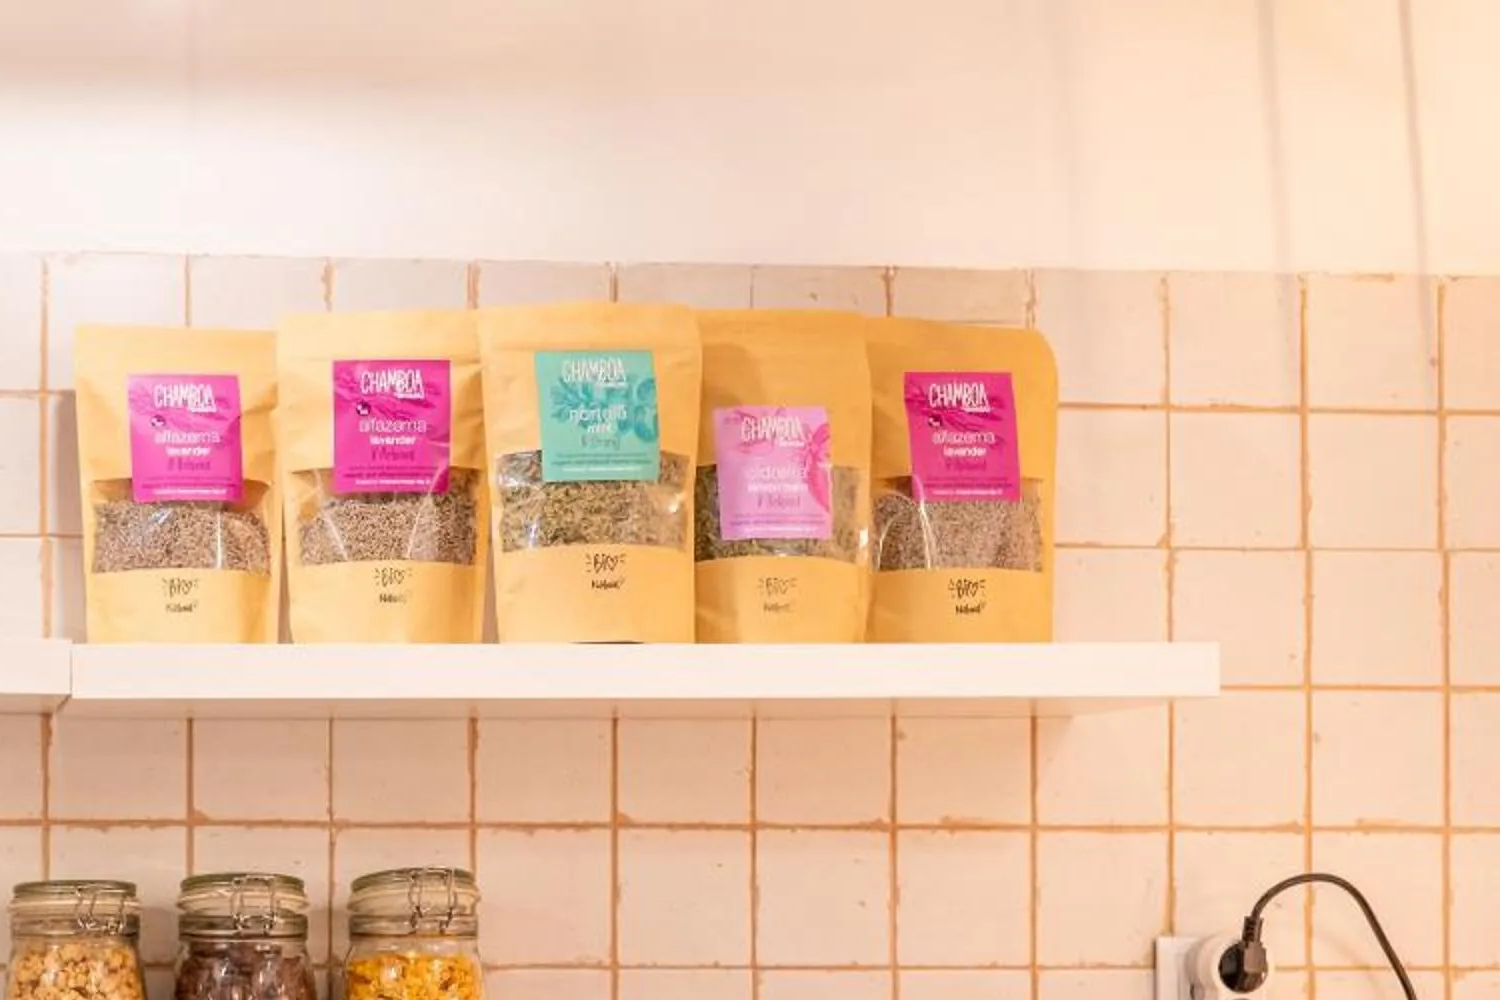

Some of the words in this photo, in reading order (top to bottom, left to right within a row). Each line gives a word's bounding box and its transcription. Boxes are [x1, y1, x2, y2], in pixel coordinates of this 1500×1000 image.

[360, 369, 424, 395] CHAMBOA
[561, 357, 626, 384] CHAMBOA
[154, 382, 217, 408] CHAMBOA
[929, 382, 990, 408] CHAMBOA
